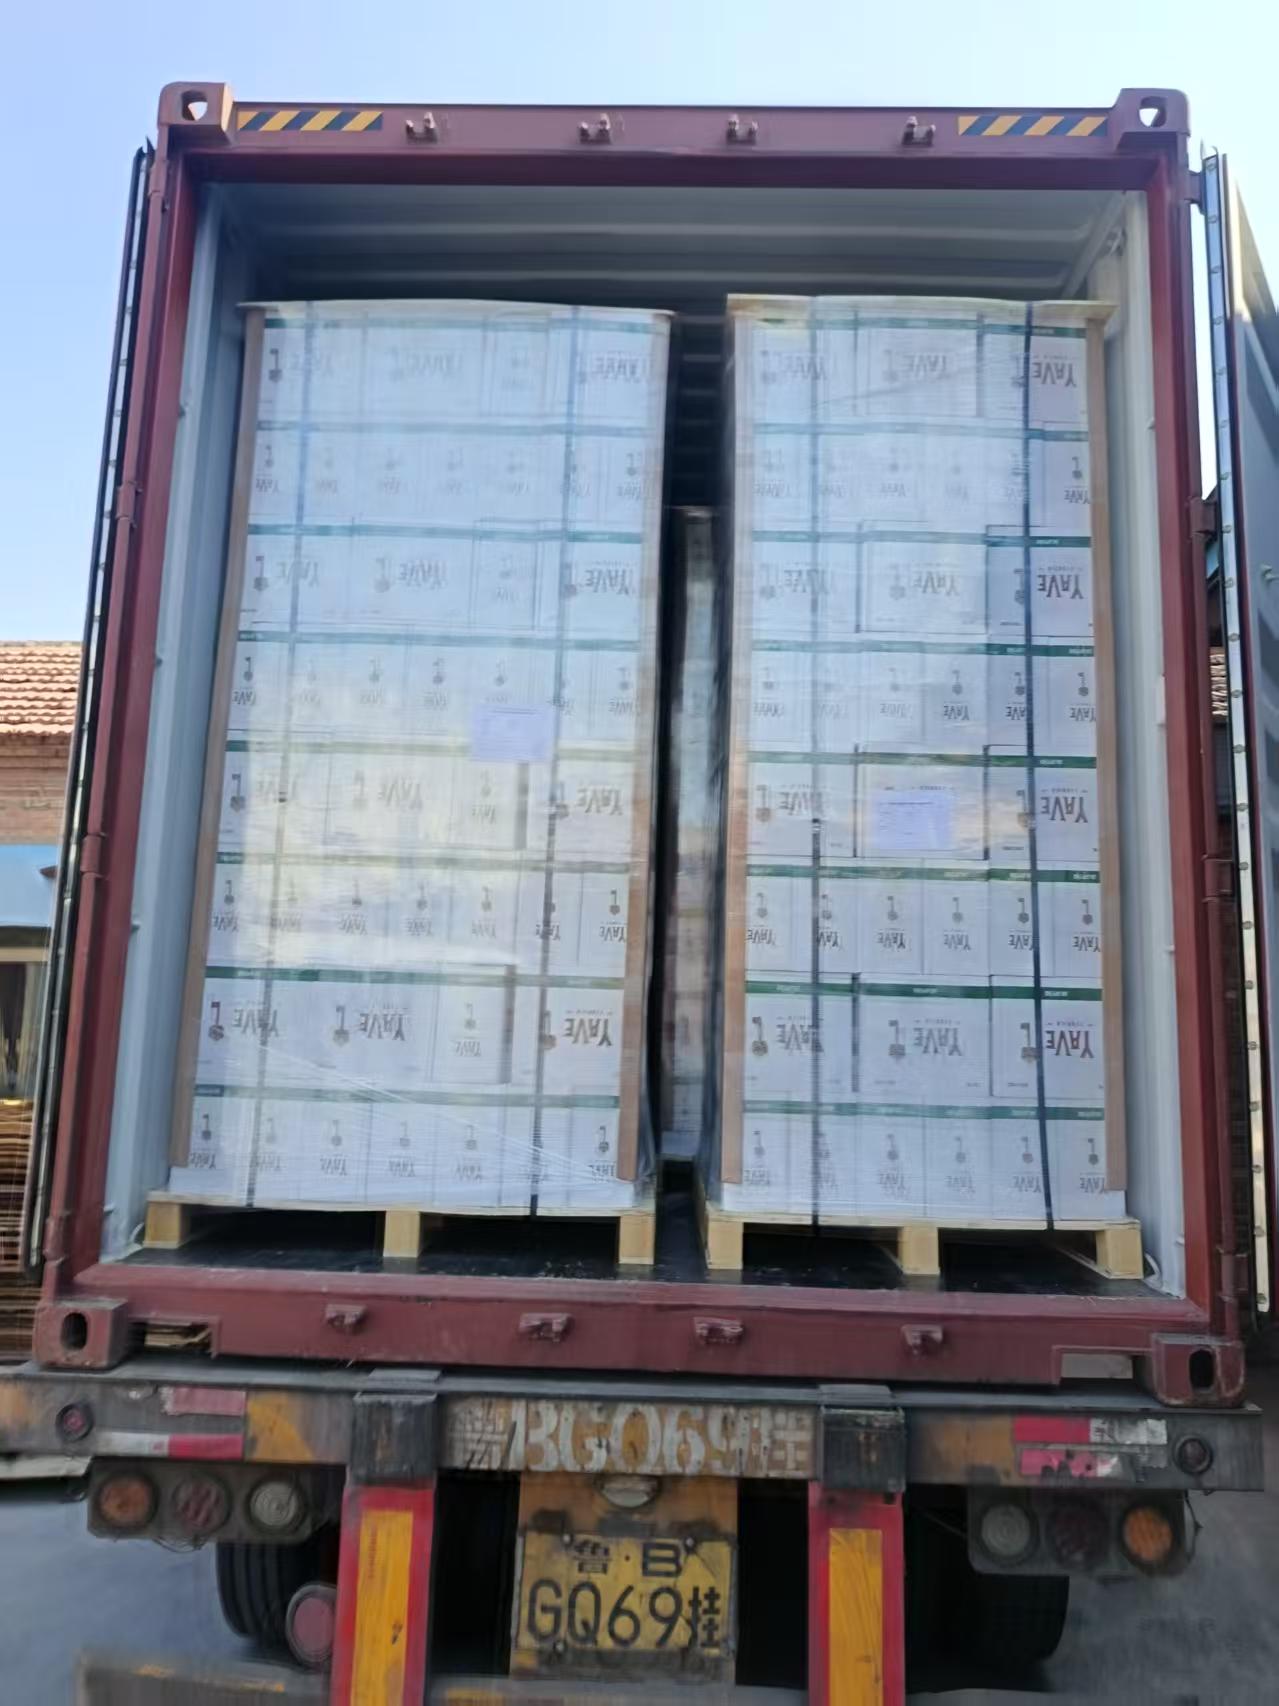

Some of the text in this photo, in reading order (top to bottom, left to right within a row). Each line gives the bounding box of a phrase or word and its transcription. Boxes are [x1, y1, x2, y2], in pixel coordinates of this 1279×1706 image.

[1031, 362, 1077, 388] YAVE
[1037, 574, 1084, 599] YAVE
[1040, 796, 1088, 823] YAVE
[876, 931, 906, 948] YAVE
[360, 1012, 406, 1041] YAVE
[564, 1018, 612, 1047] YAVE
[913, 1027, 962, 1056] YAVE
[1045, 1030, 1094, 1058] YAVE
[527, 1578, 722, 1648] GQ69挂
